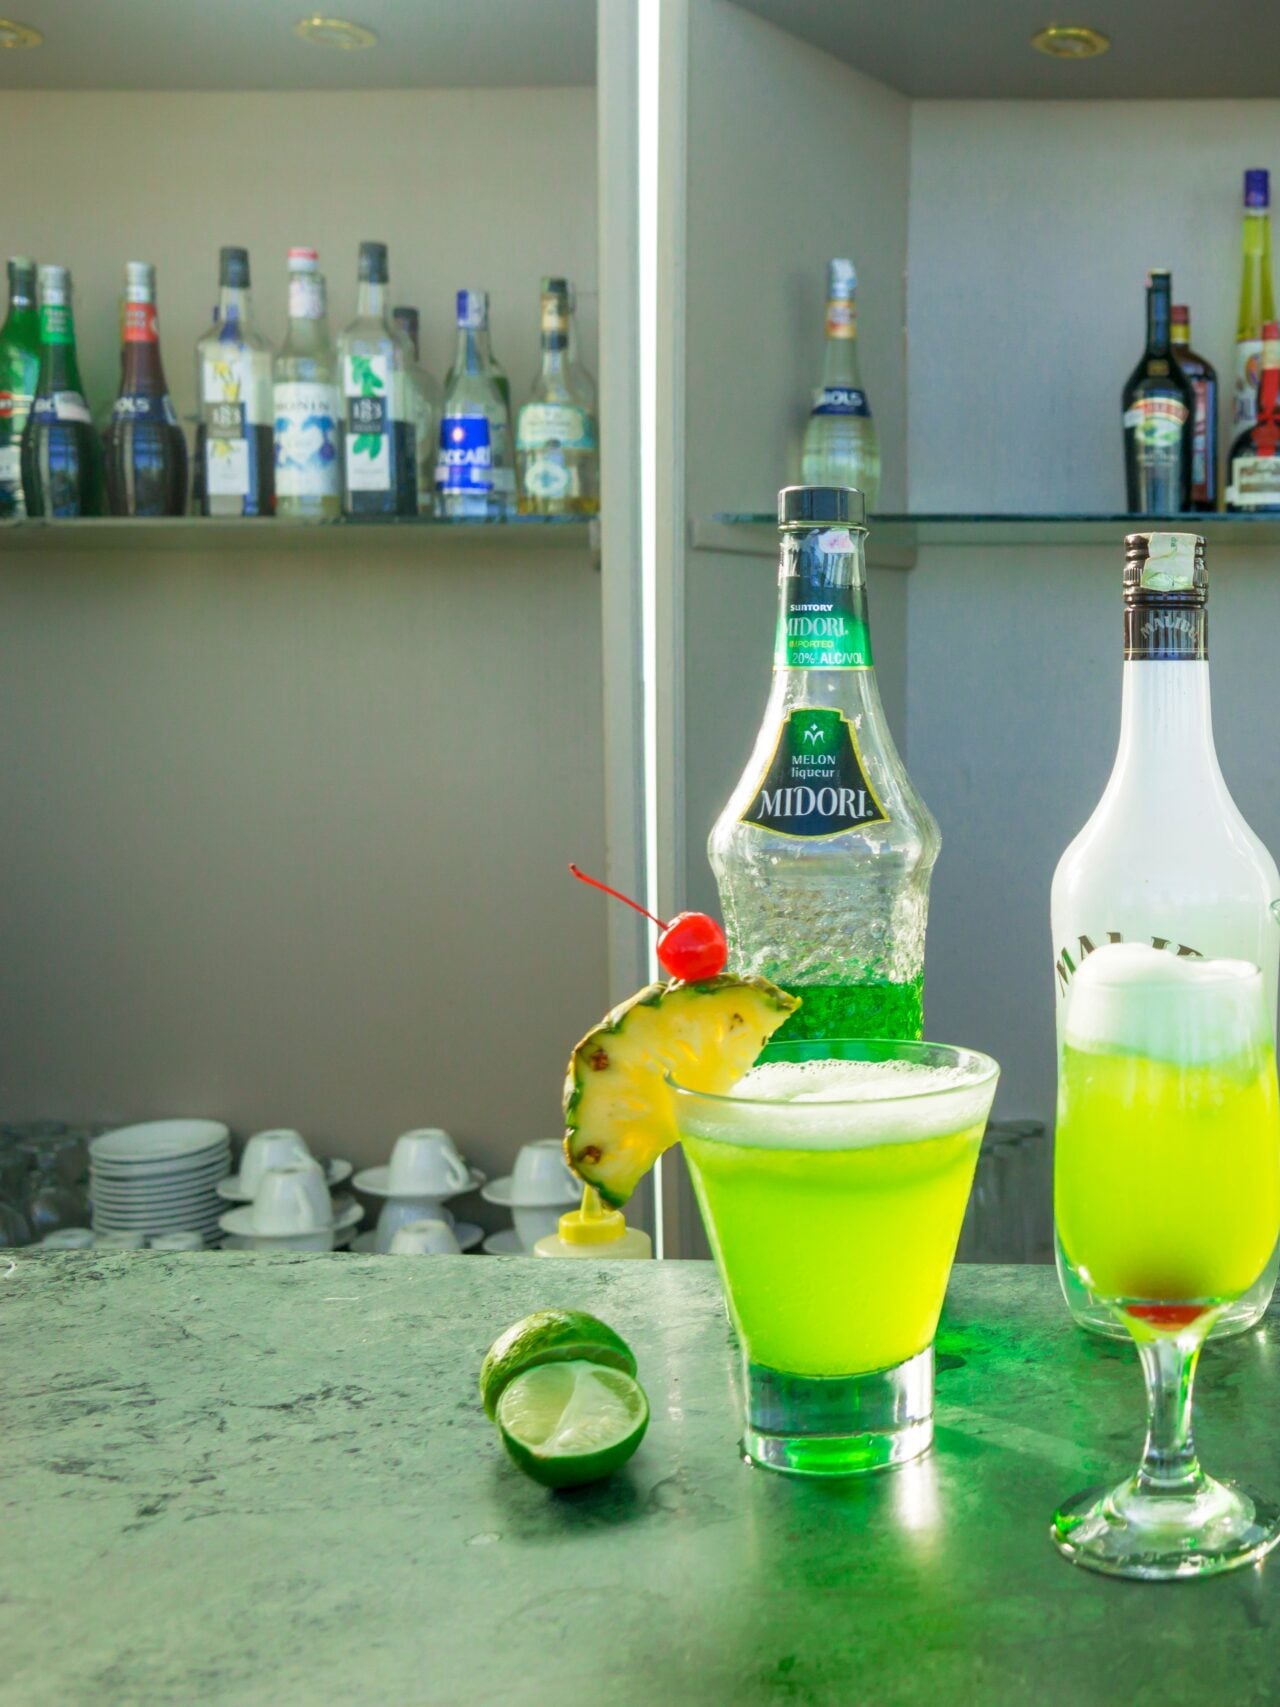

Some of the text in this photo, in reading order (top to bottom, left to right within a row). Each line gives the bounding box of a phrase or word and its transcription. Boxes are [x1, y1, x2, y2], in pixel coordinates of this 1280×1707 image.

[792, 652, 815, 664] 20%
[791, 754, 836, 765] MELON
[791, 767, 835, 779] liqueur
[757, 786, 868, 819] MIDORI
